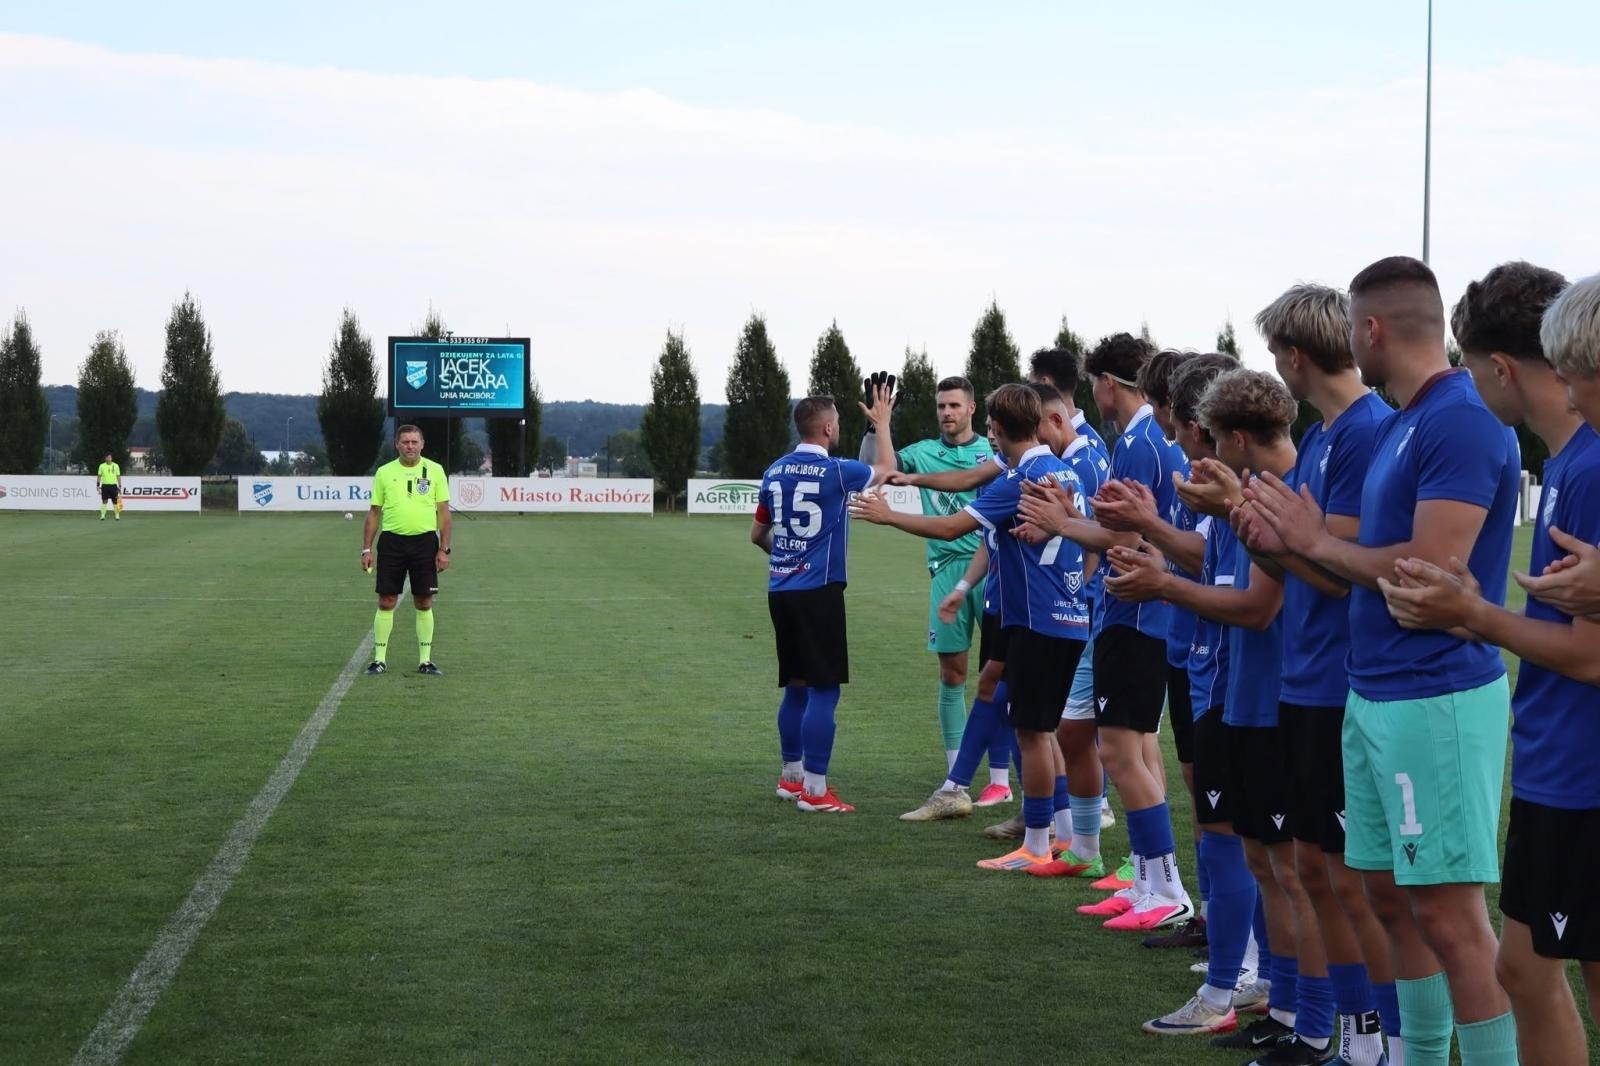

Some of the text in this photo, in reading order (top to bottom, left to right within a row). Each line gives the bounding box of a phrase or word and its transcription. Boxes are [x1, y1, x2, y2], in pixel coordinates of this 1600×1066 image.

[440, 352, 483, 360] DZIĘKUJEMY
[439, 359, 491, 378] JACEK
[440, 374, 509, 389] SALARA
[459, 390, 496, 399] RACIBÓRZ
[10, 487, 92, 498] SONING STAL
[296, 485, 341, 500] Unia
[500, 487, 651, 504] Miasto Racibórz
[768, 481, 822, 538] 15
[1395, 773, 1423, 835] 1
